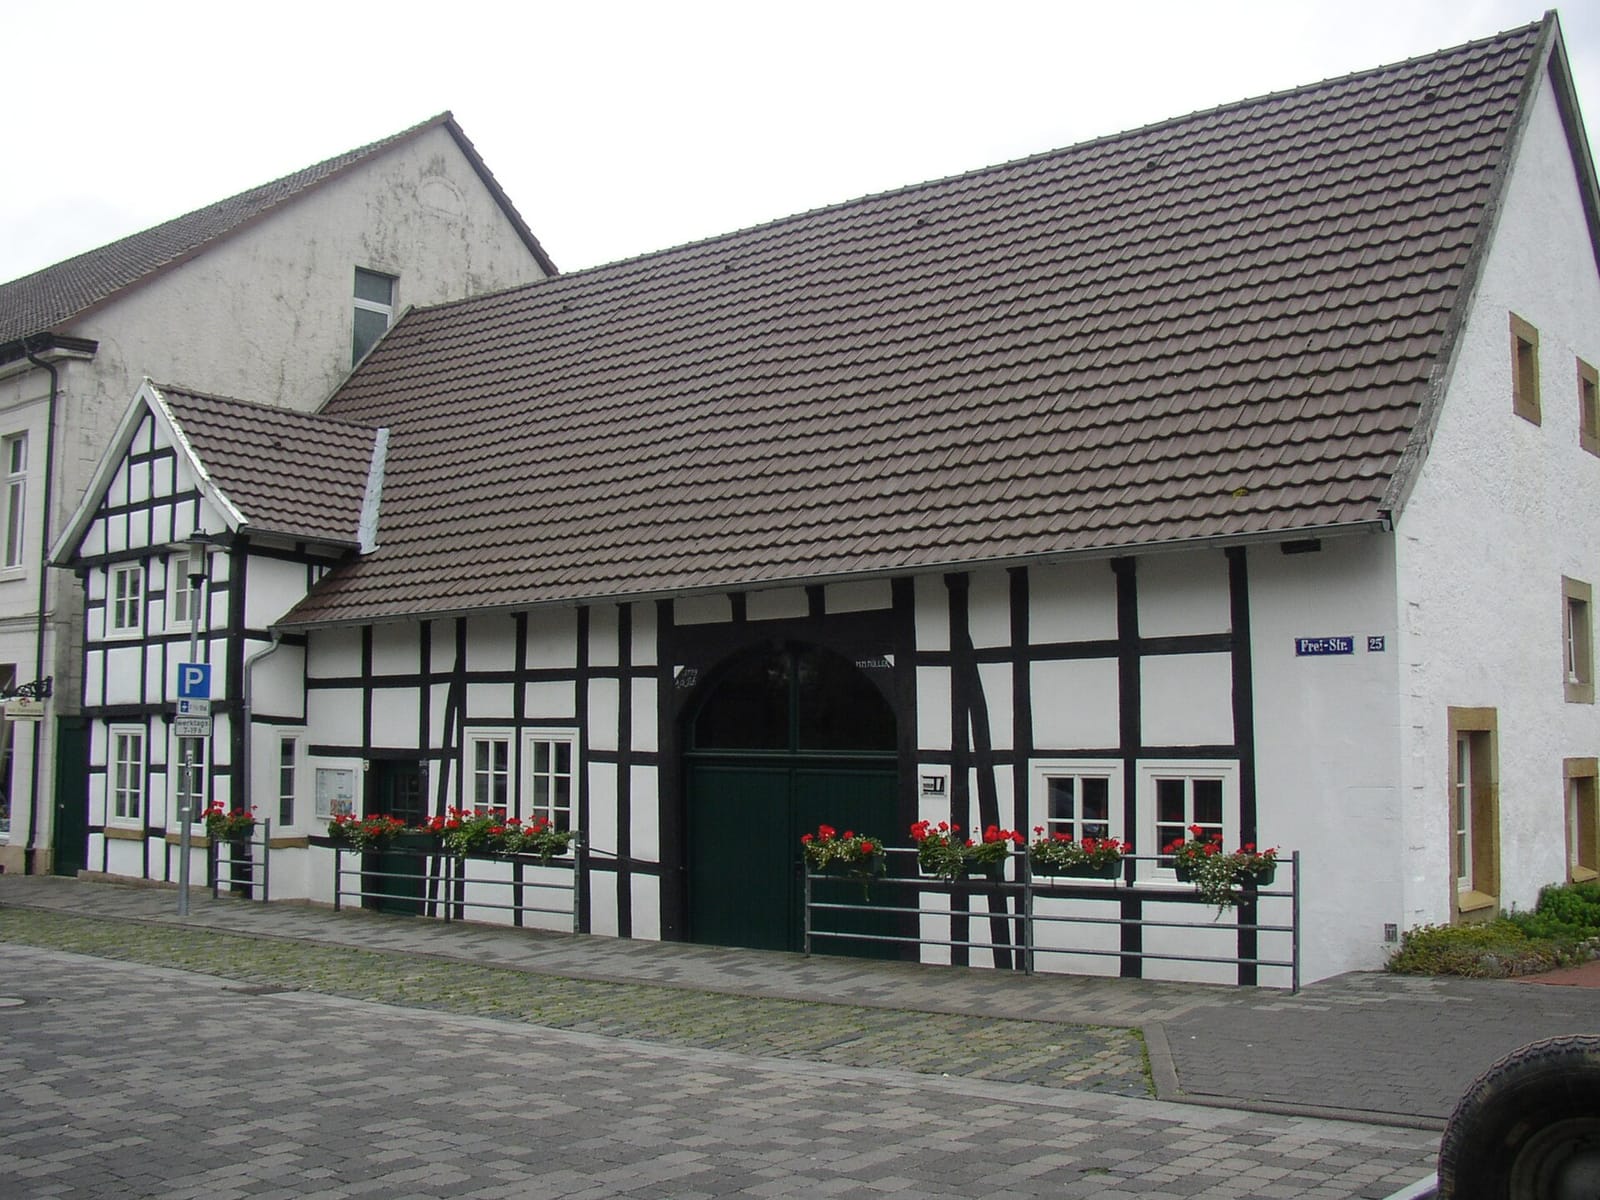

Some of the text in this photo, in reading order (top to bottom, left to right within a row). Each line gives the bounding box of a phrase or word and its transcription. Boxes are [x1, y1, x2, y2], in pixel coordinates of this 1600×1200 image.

[1300, 638, 1348, 653] Frei-Str.
[1369, 638, 1382, 650] 25
[184, 667, 204, 695] P
